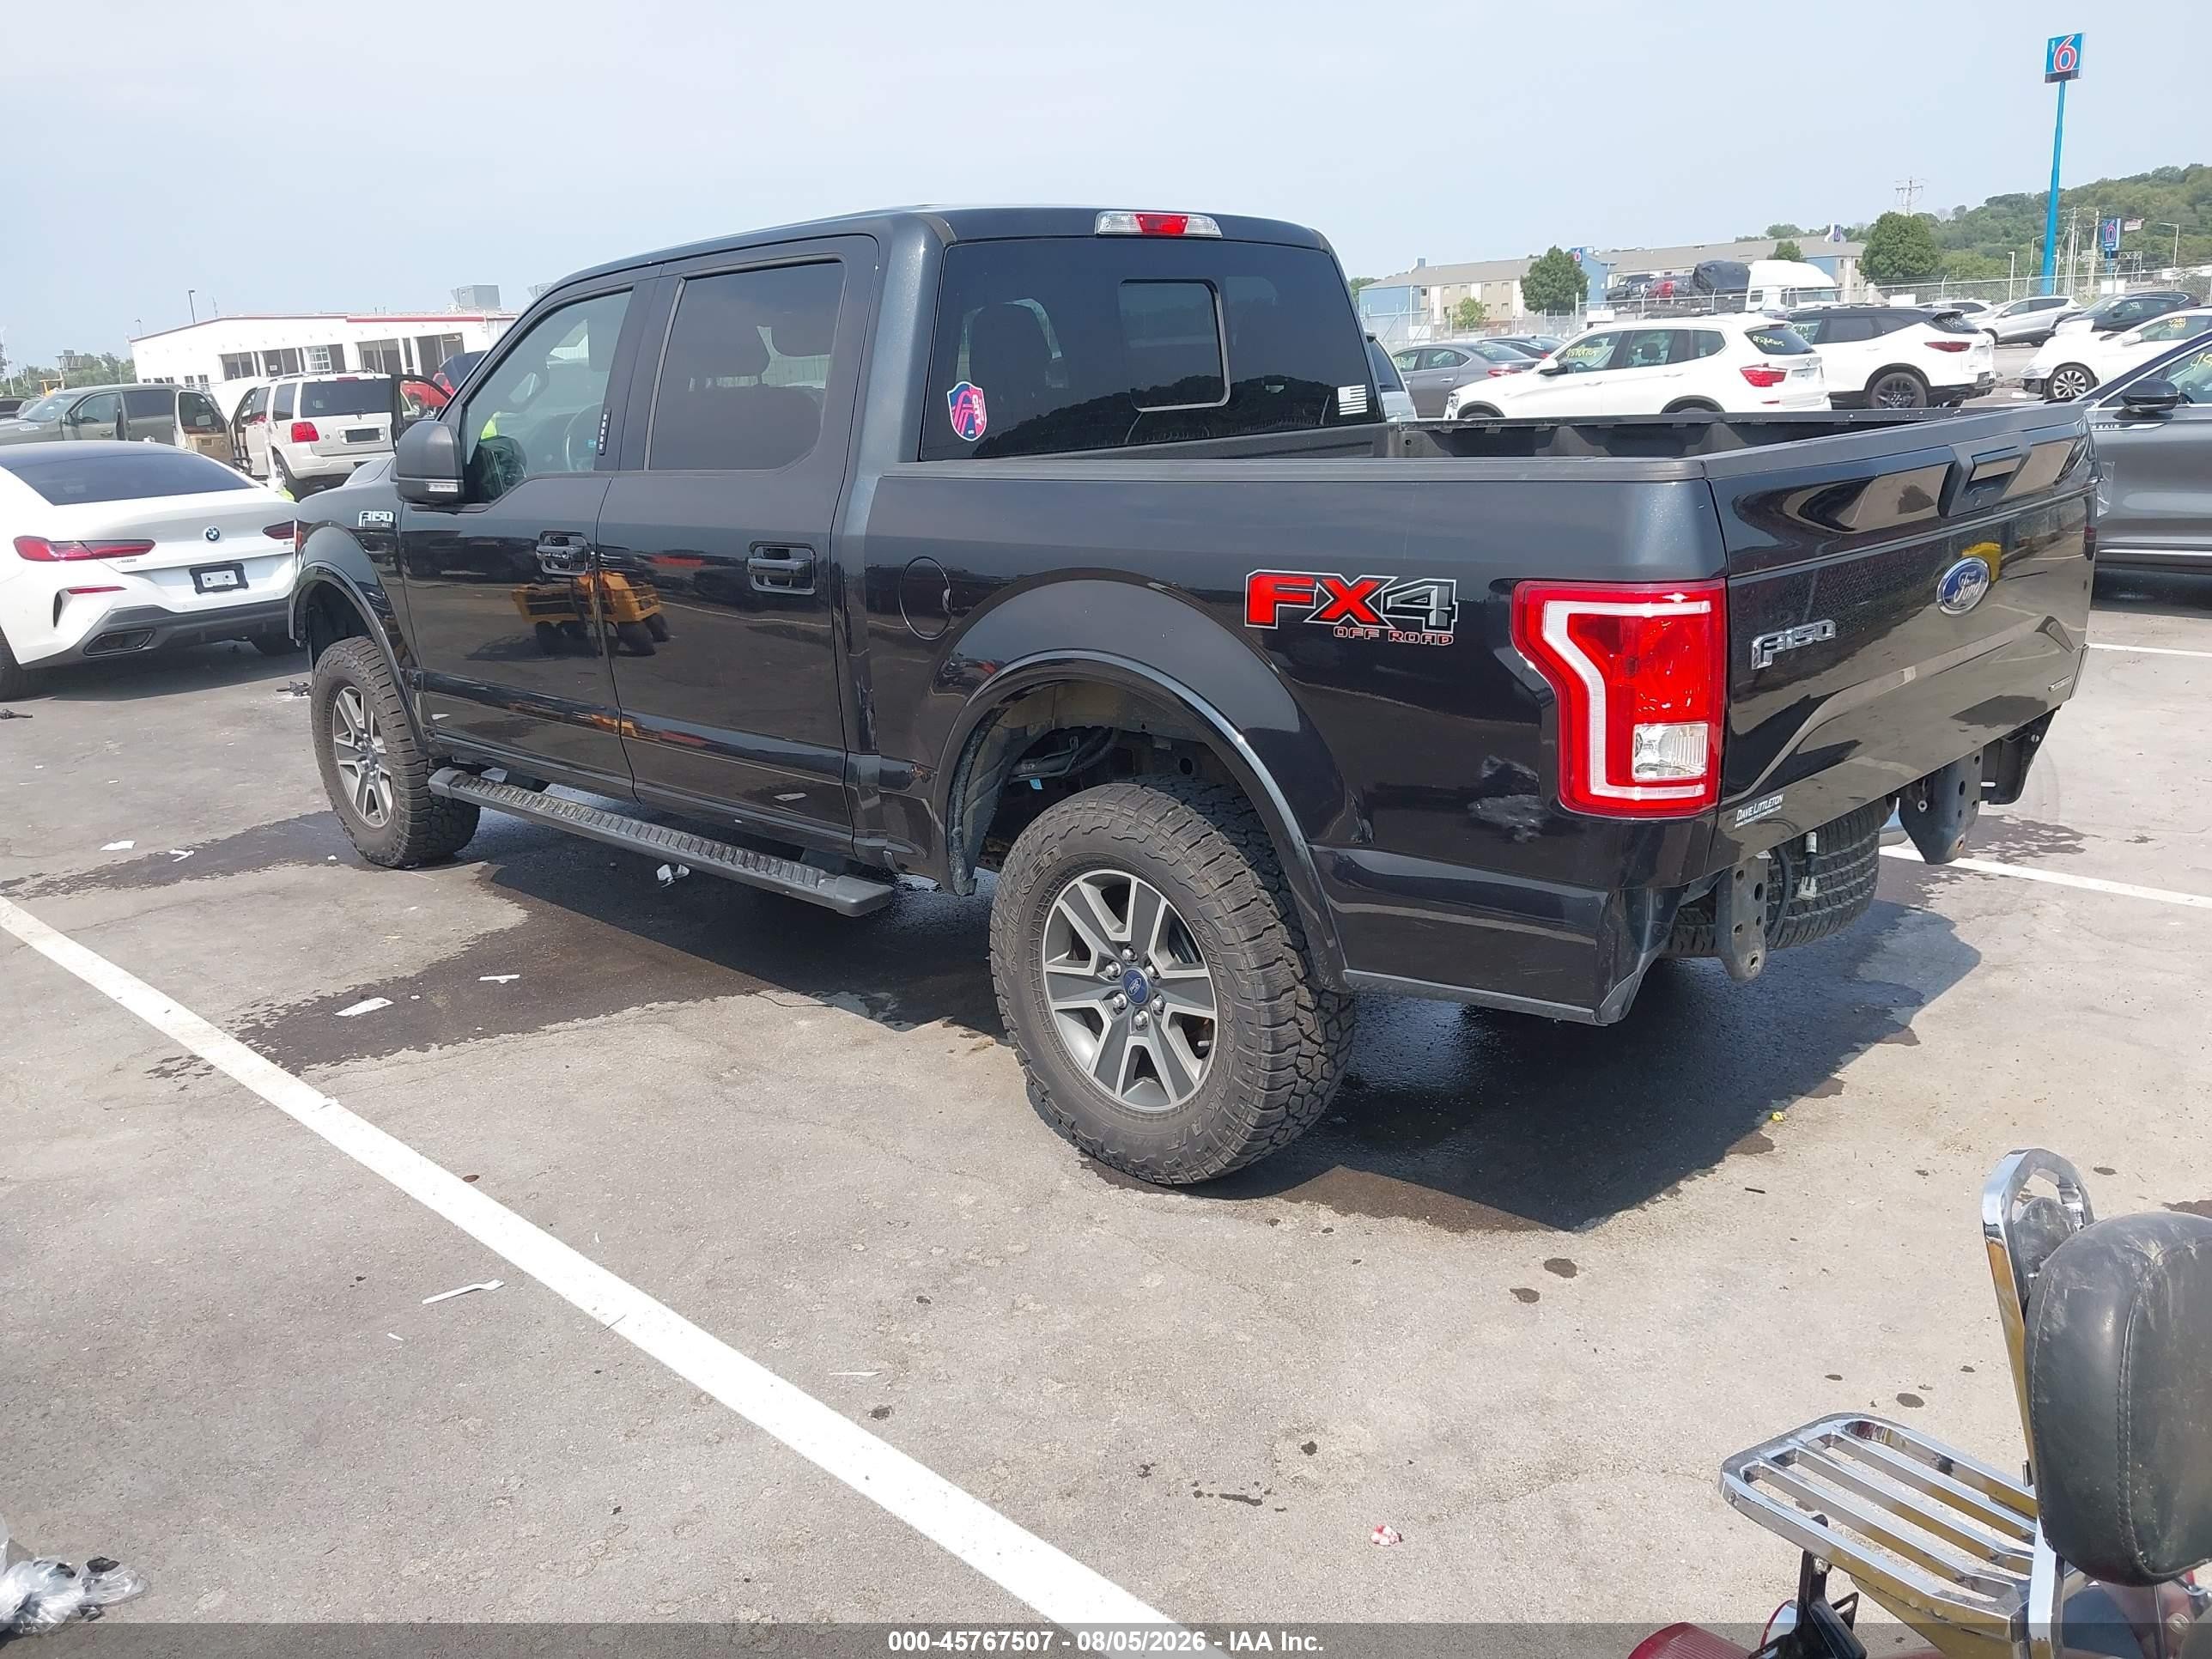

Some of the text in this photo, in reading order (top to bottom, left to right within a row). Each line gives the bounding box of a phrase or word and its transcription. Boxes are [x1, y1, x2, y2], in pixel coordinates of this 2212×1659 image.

[2053, 34, 2077, 73] 6
[1244, 568, 1459, 634] FX4
[1952, 569, 1984, 604] Ford
[1333, 626, 1454, 646] OFF ROAD
